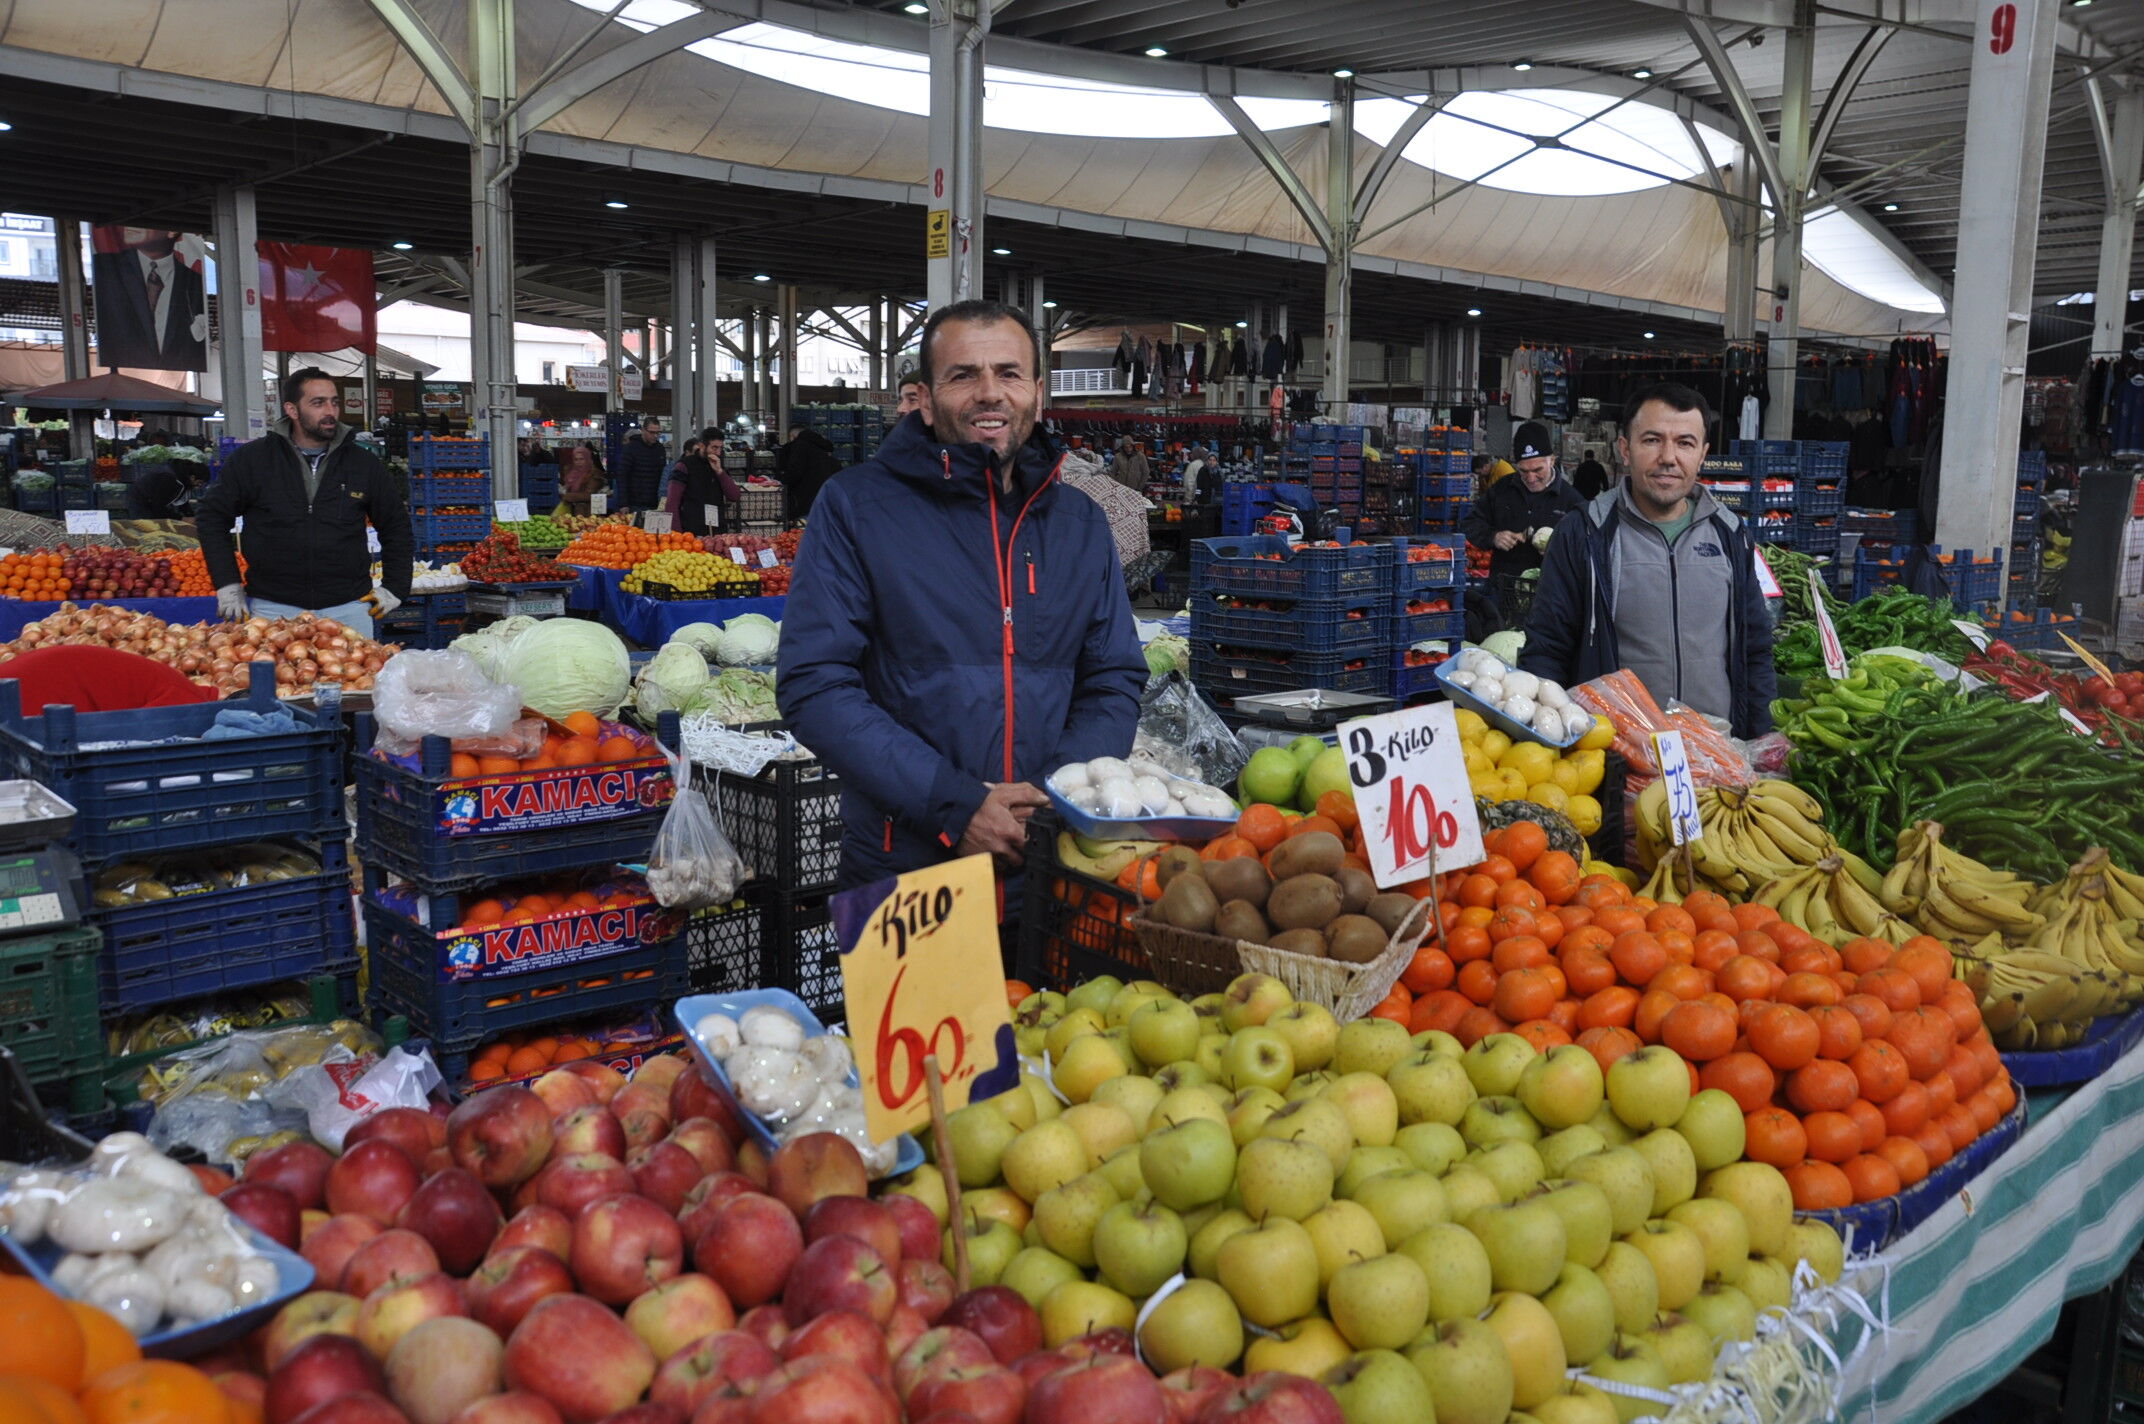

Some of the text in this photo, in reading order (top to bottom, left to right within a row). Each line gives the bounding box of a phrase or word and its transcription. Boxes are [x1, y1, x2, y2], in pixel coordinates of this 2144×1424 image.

[1990, 3, 2017, 55] 9
[934, 167, 944, 199] 8
[72, 313, 82, 327] 5
[246, 288, 255, 305] 6
[1327, 324, 1334, 339] 7
[1349, 727, 1386, 787] 3
[482, 771, 635, 819] KAMACI
[1383, 775, 1458, 869] 100
[485, 908, 636, 965] KAMACI
[875, 964, 965, 1110] 60
